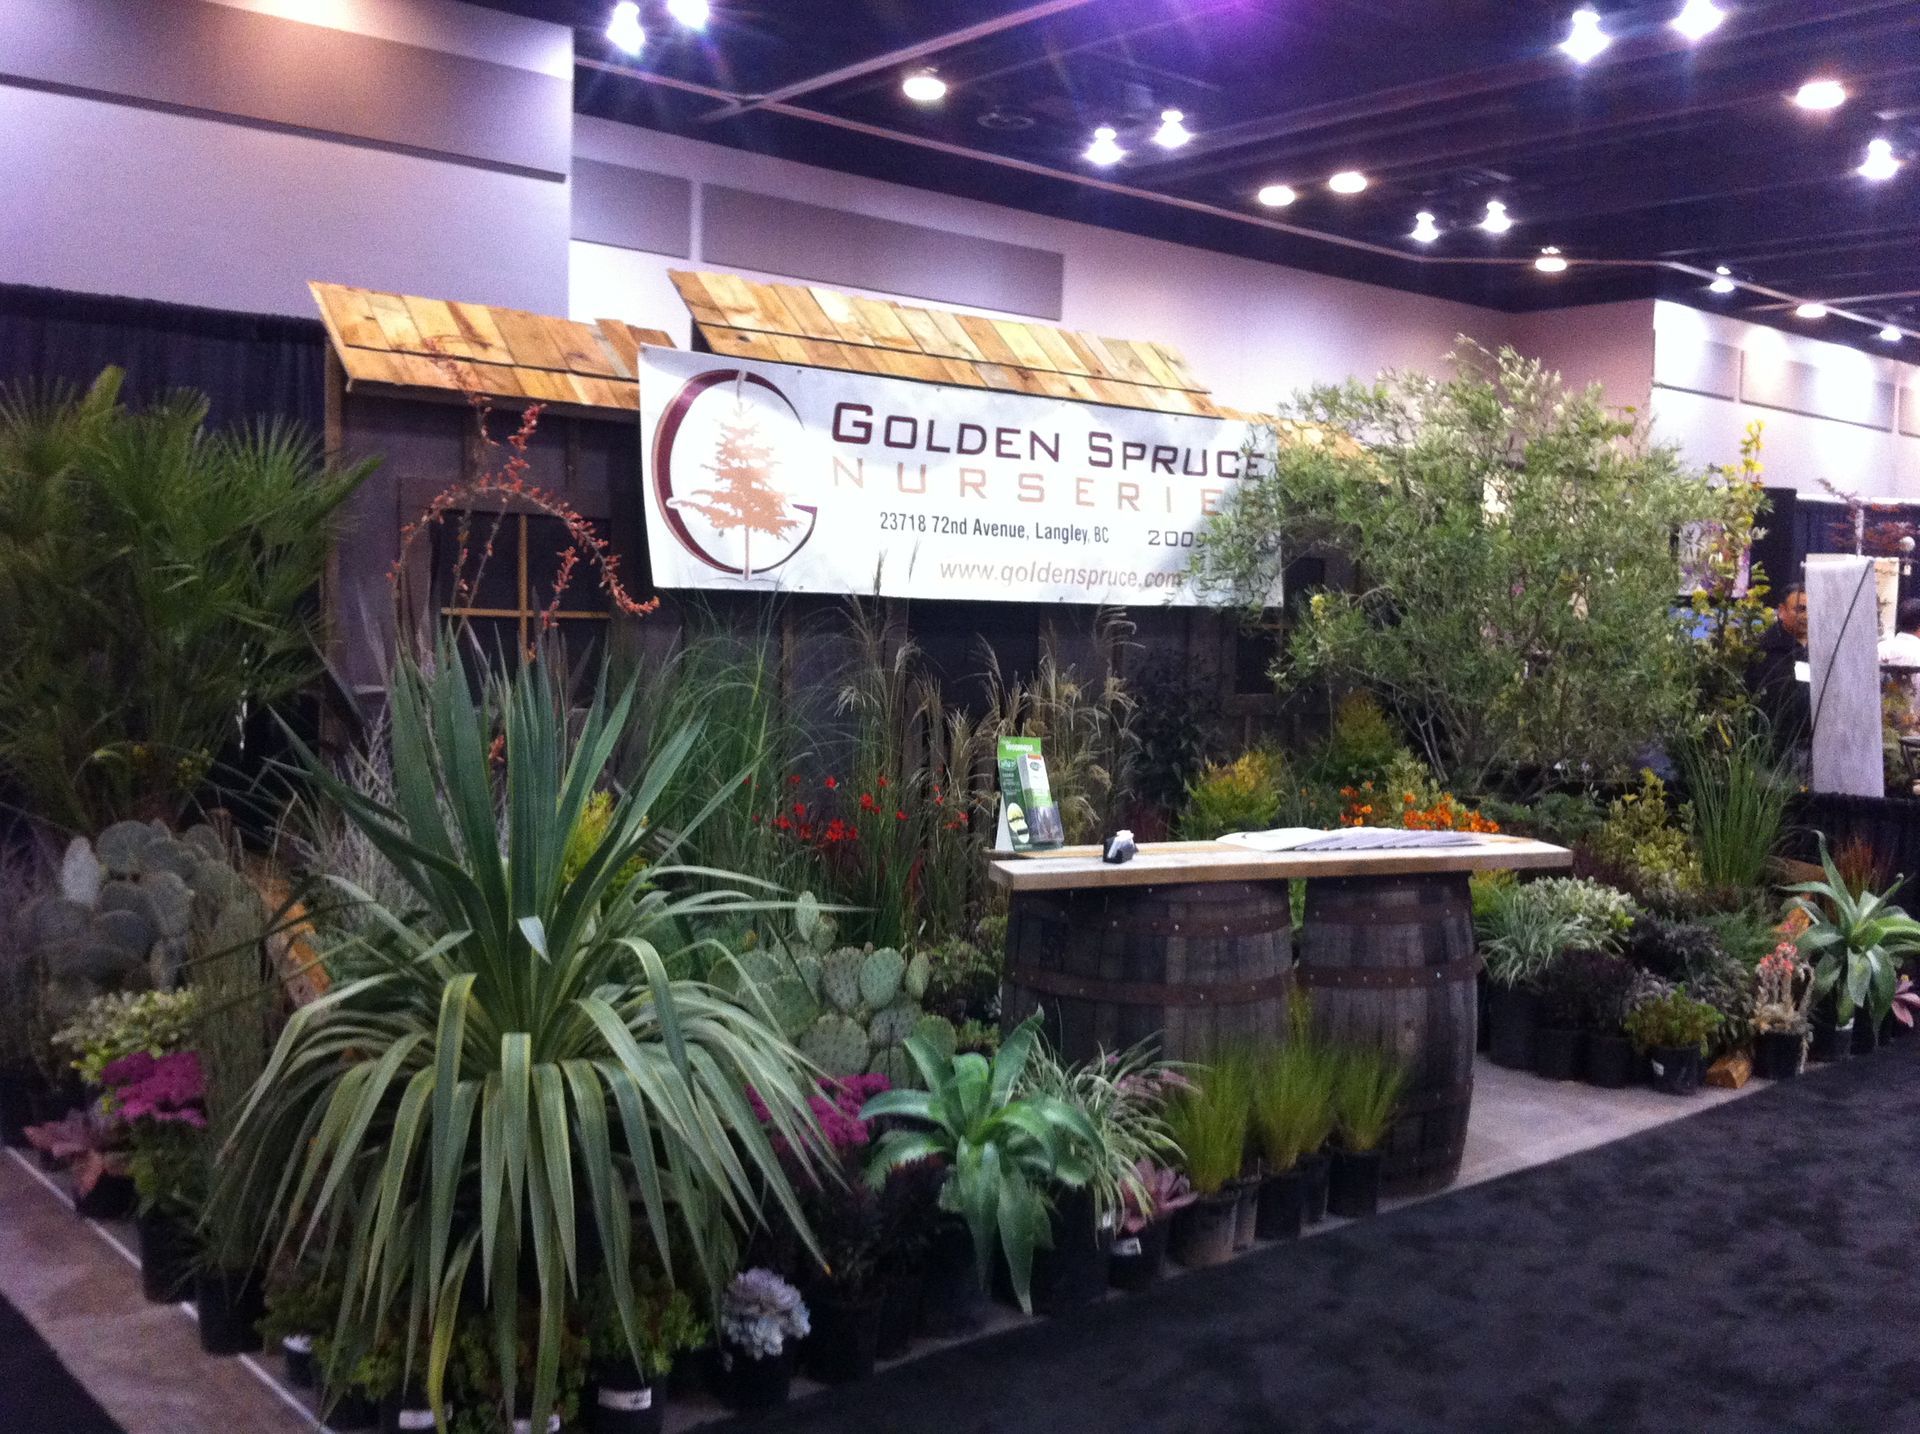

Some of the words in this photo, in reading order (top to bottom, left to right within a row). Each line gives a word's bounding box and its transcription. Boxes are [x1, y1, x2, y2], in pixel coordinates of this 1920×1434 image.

[832, 402, 1060, 463] GOLDEN
[1088, 431, 1265, 482] SPRUCE
[832, 455, 1225, 517] NURSERIE
[880, 511, 927, 533] 23718
[931, 515, 968, 536] 72nd
[972, 518, 1030, 541] Avenue,
[1094, 526, 1110, 544] BC
[940, 560, 1183, 592] www.goldenspruce.com
